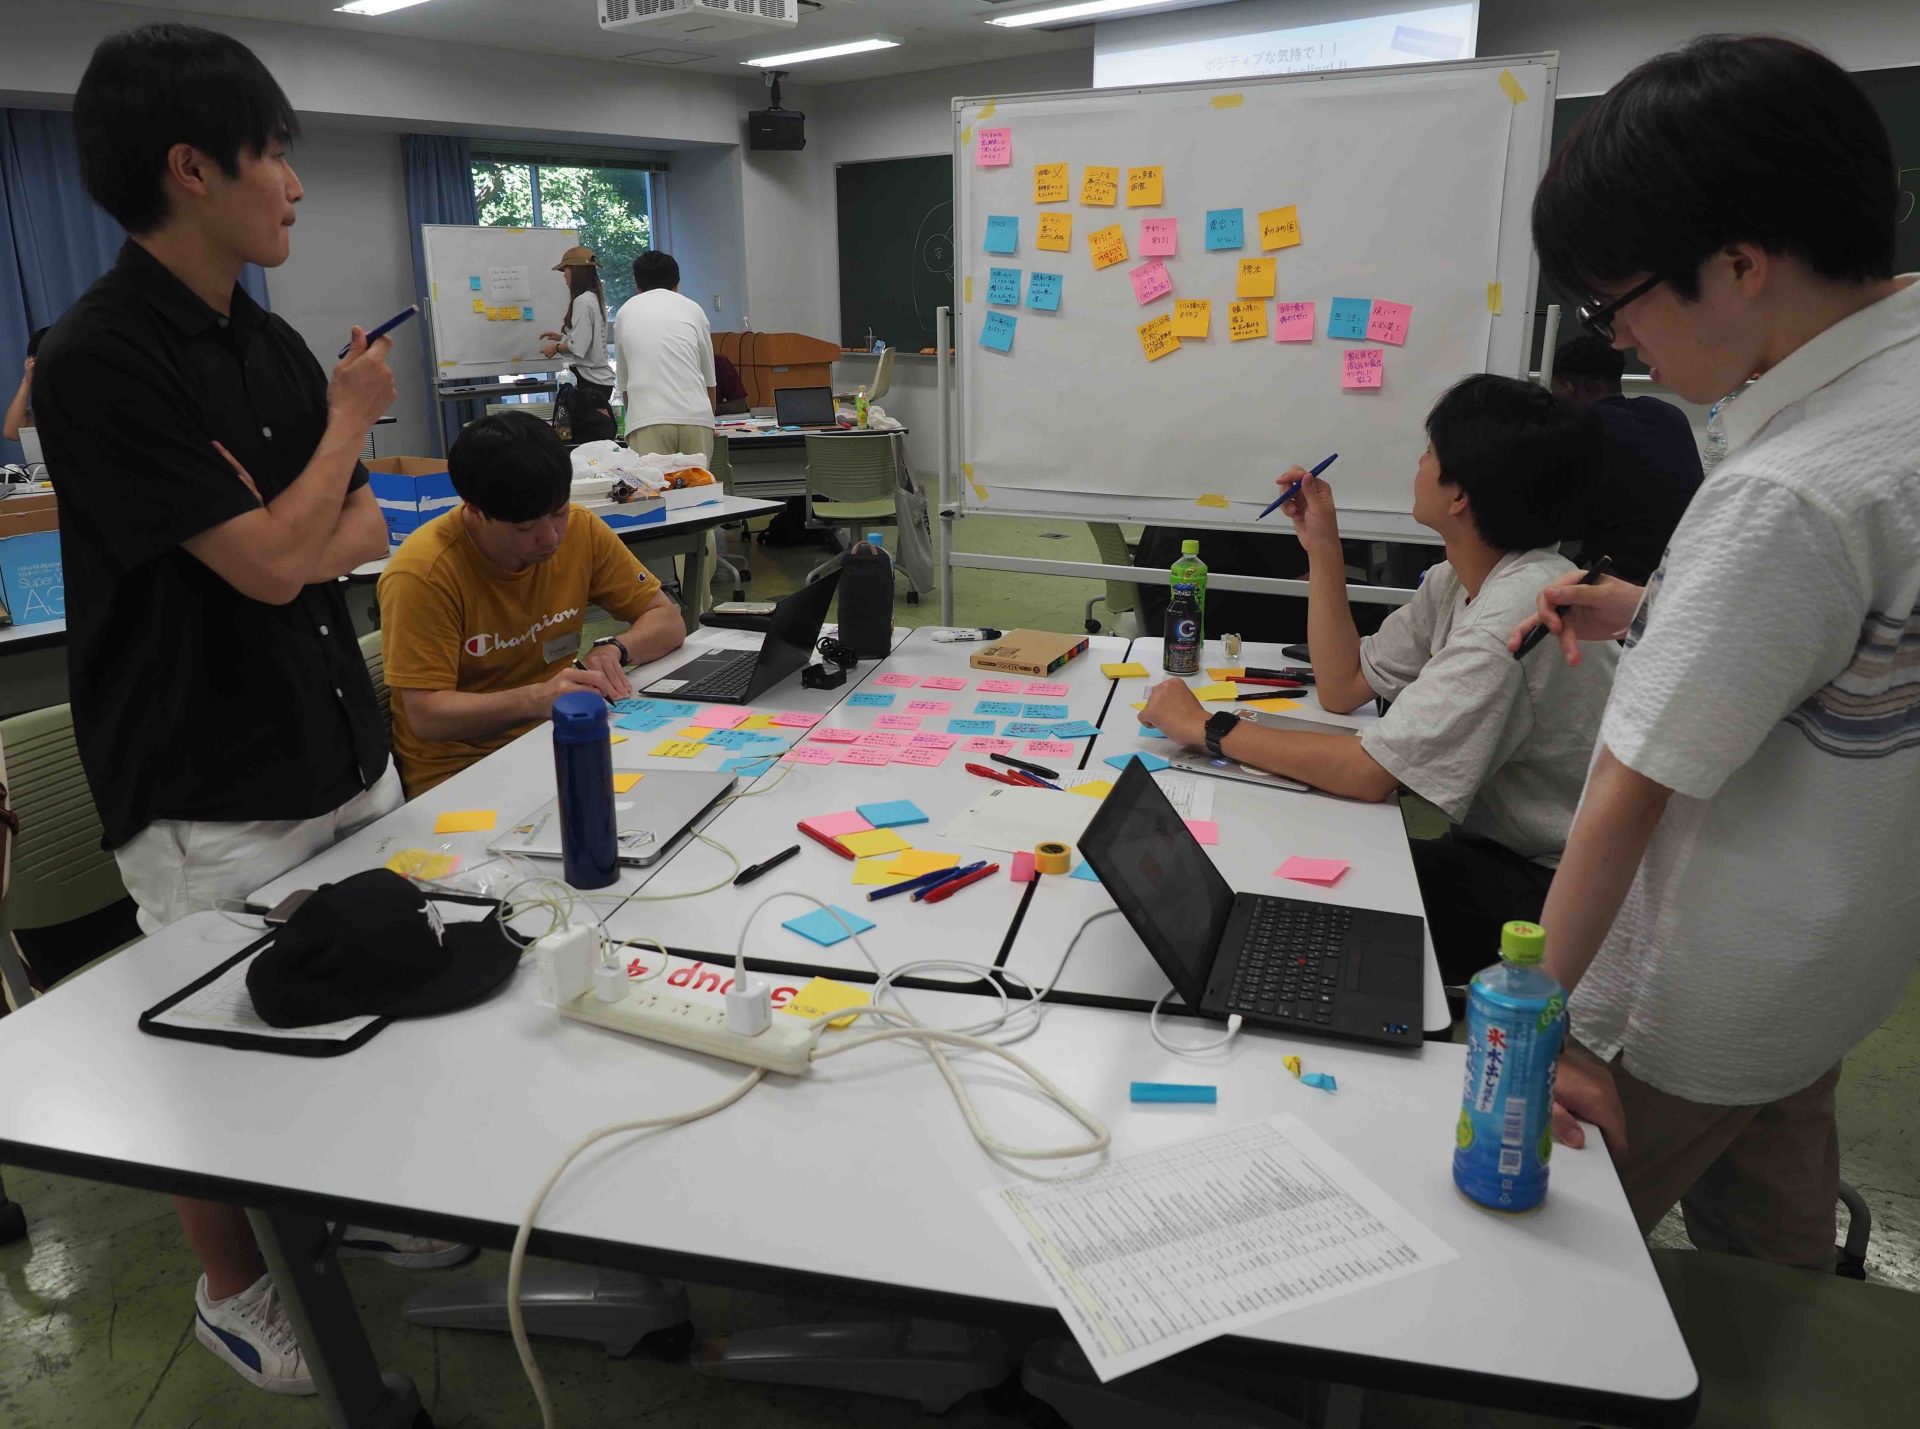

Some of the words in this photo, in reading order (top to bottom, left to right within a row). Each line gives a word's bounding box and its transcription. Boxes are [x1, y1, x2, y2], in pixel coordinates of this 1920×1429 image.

[19, 578, 53, 589] Super
[465, 608, 578, 657] Champion
[667, 961, 800, 1010] Gup
